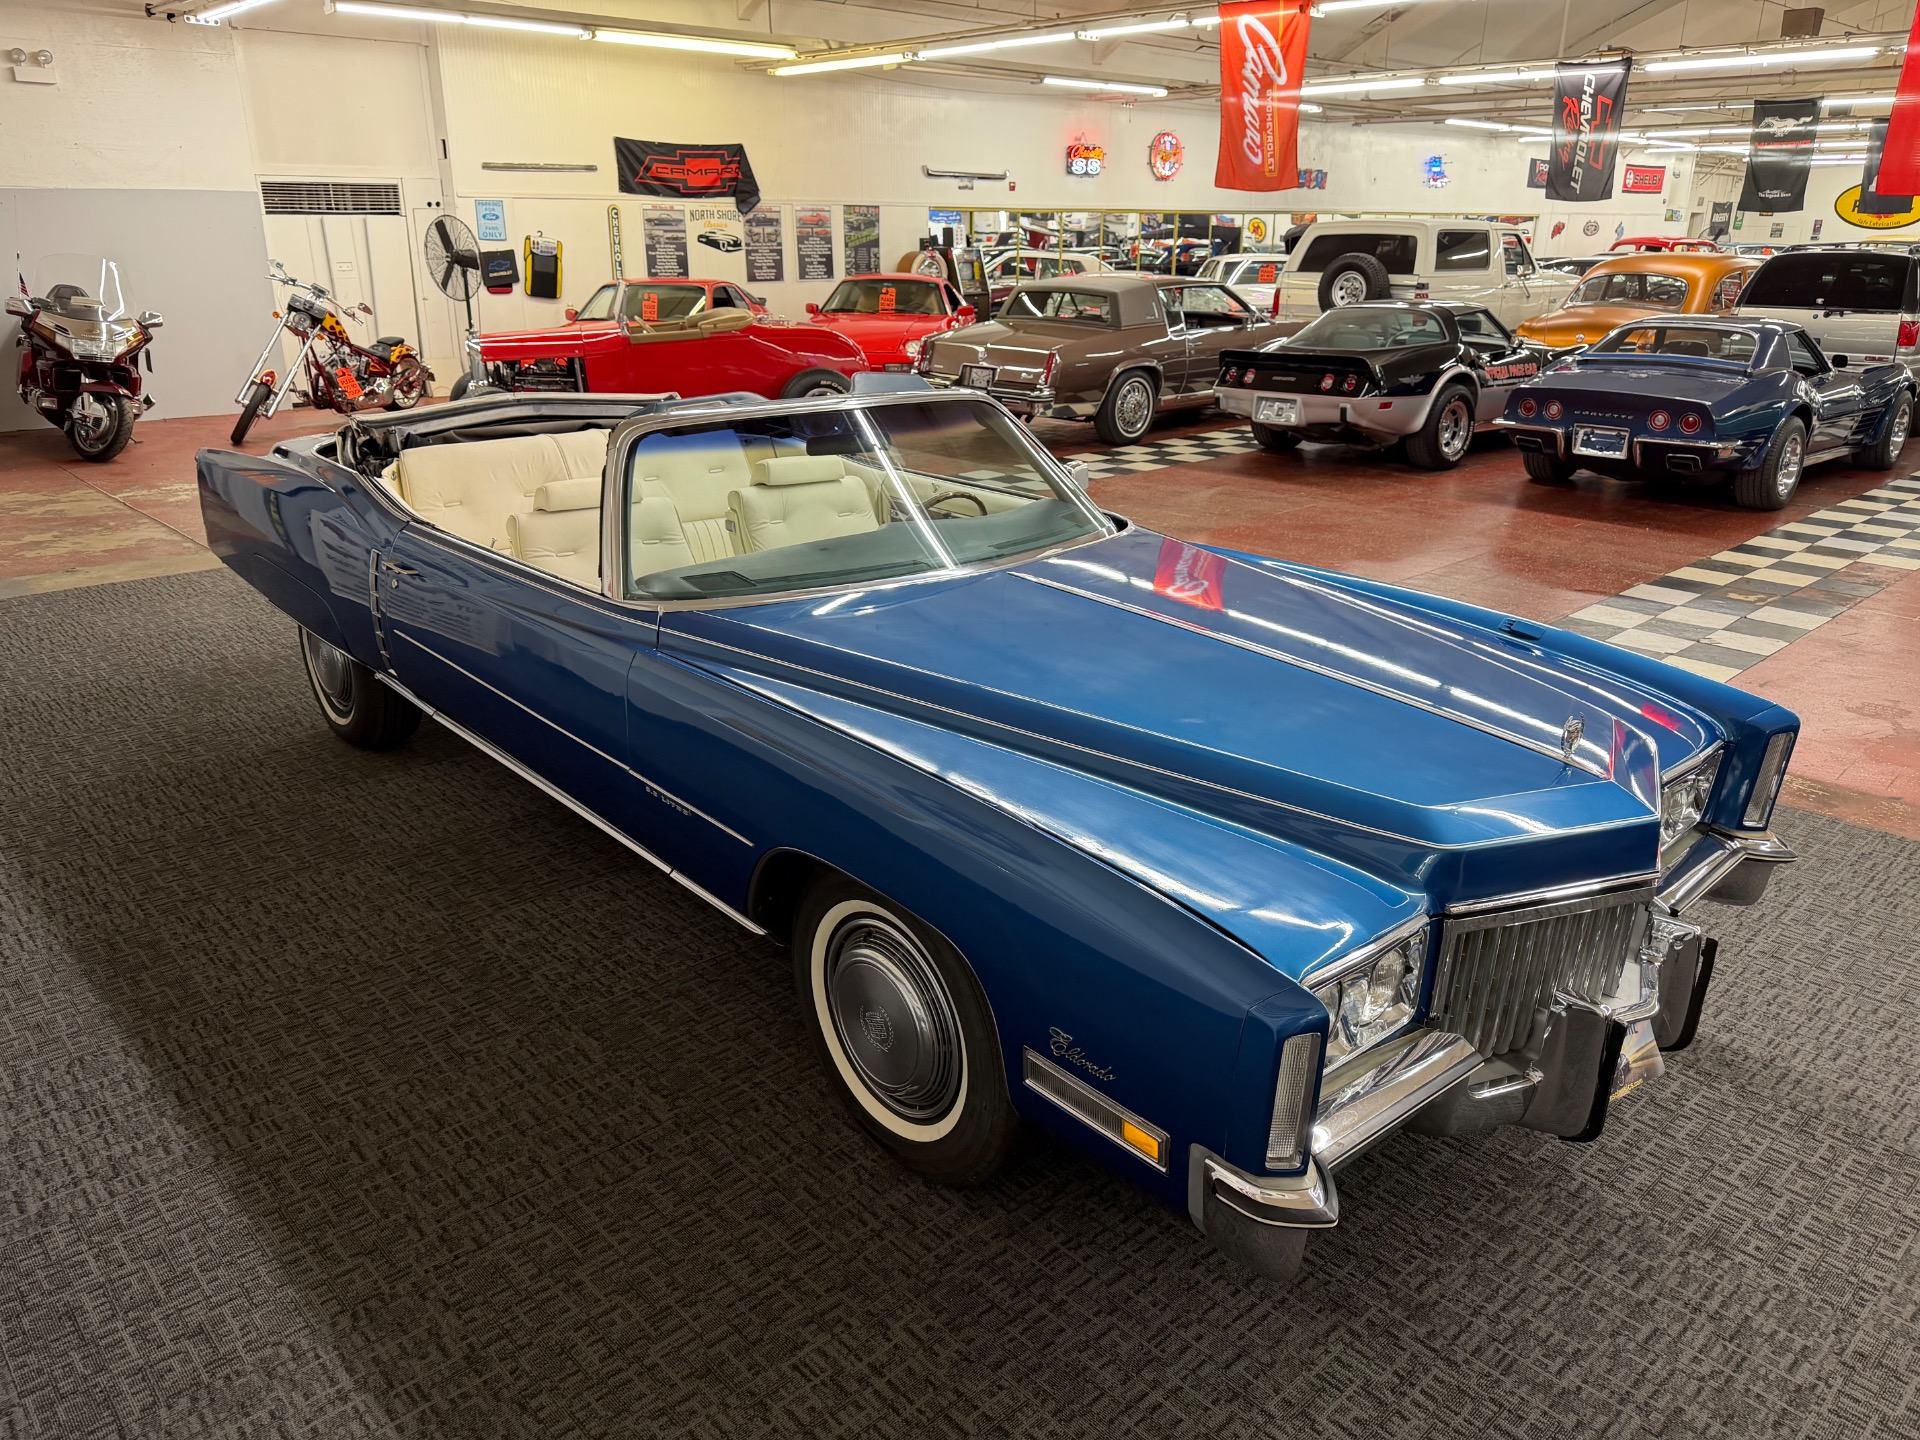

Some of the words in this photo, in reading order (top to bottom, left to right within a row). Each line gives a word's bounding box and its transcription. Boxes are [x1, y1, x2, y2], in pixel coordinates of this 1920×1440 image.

[1237, 14, 1288, 166] Camaro
[1265, 105, 1275, 172] CHEVROLET
[1570, 73, 1596, 194] CHEVROLET
[1071, 158, 1101, 175] SS
[1633, 174, 1663, 186] SHELBY
[689, 208, 715, 222] NORTH
[716, 208, 742, 223] SHORE
[703, 220, 729, 228] Classics
[1574, 410, 1634, 420] CORVETTE
[1049, 1026, 1117, 1081] Eldorado
